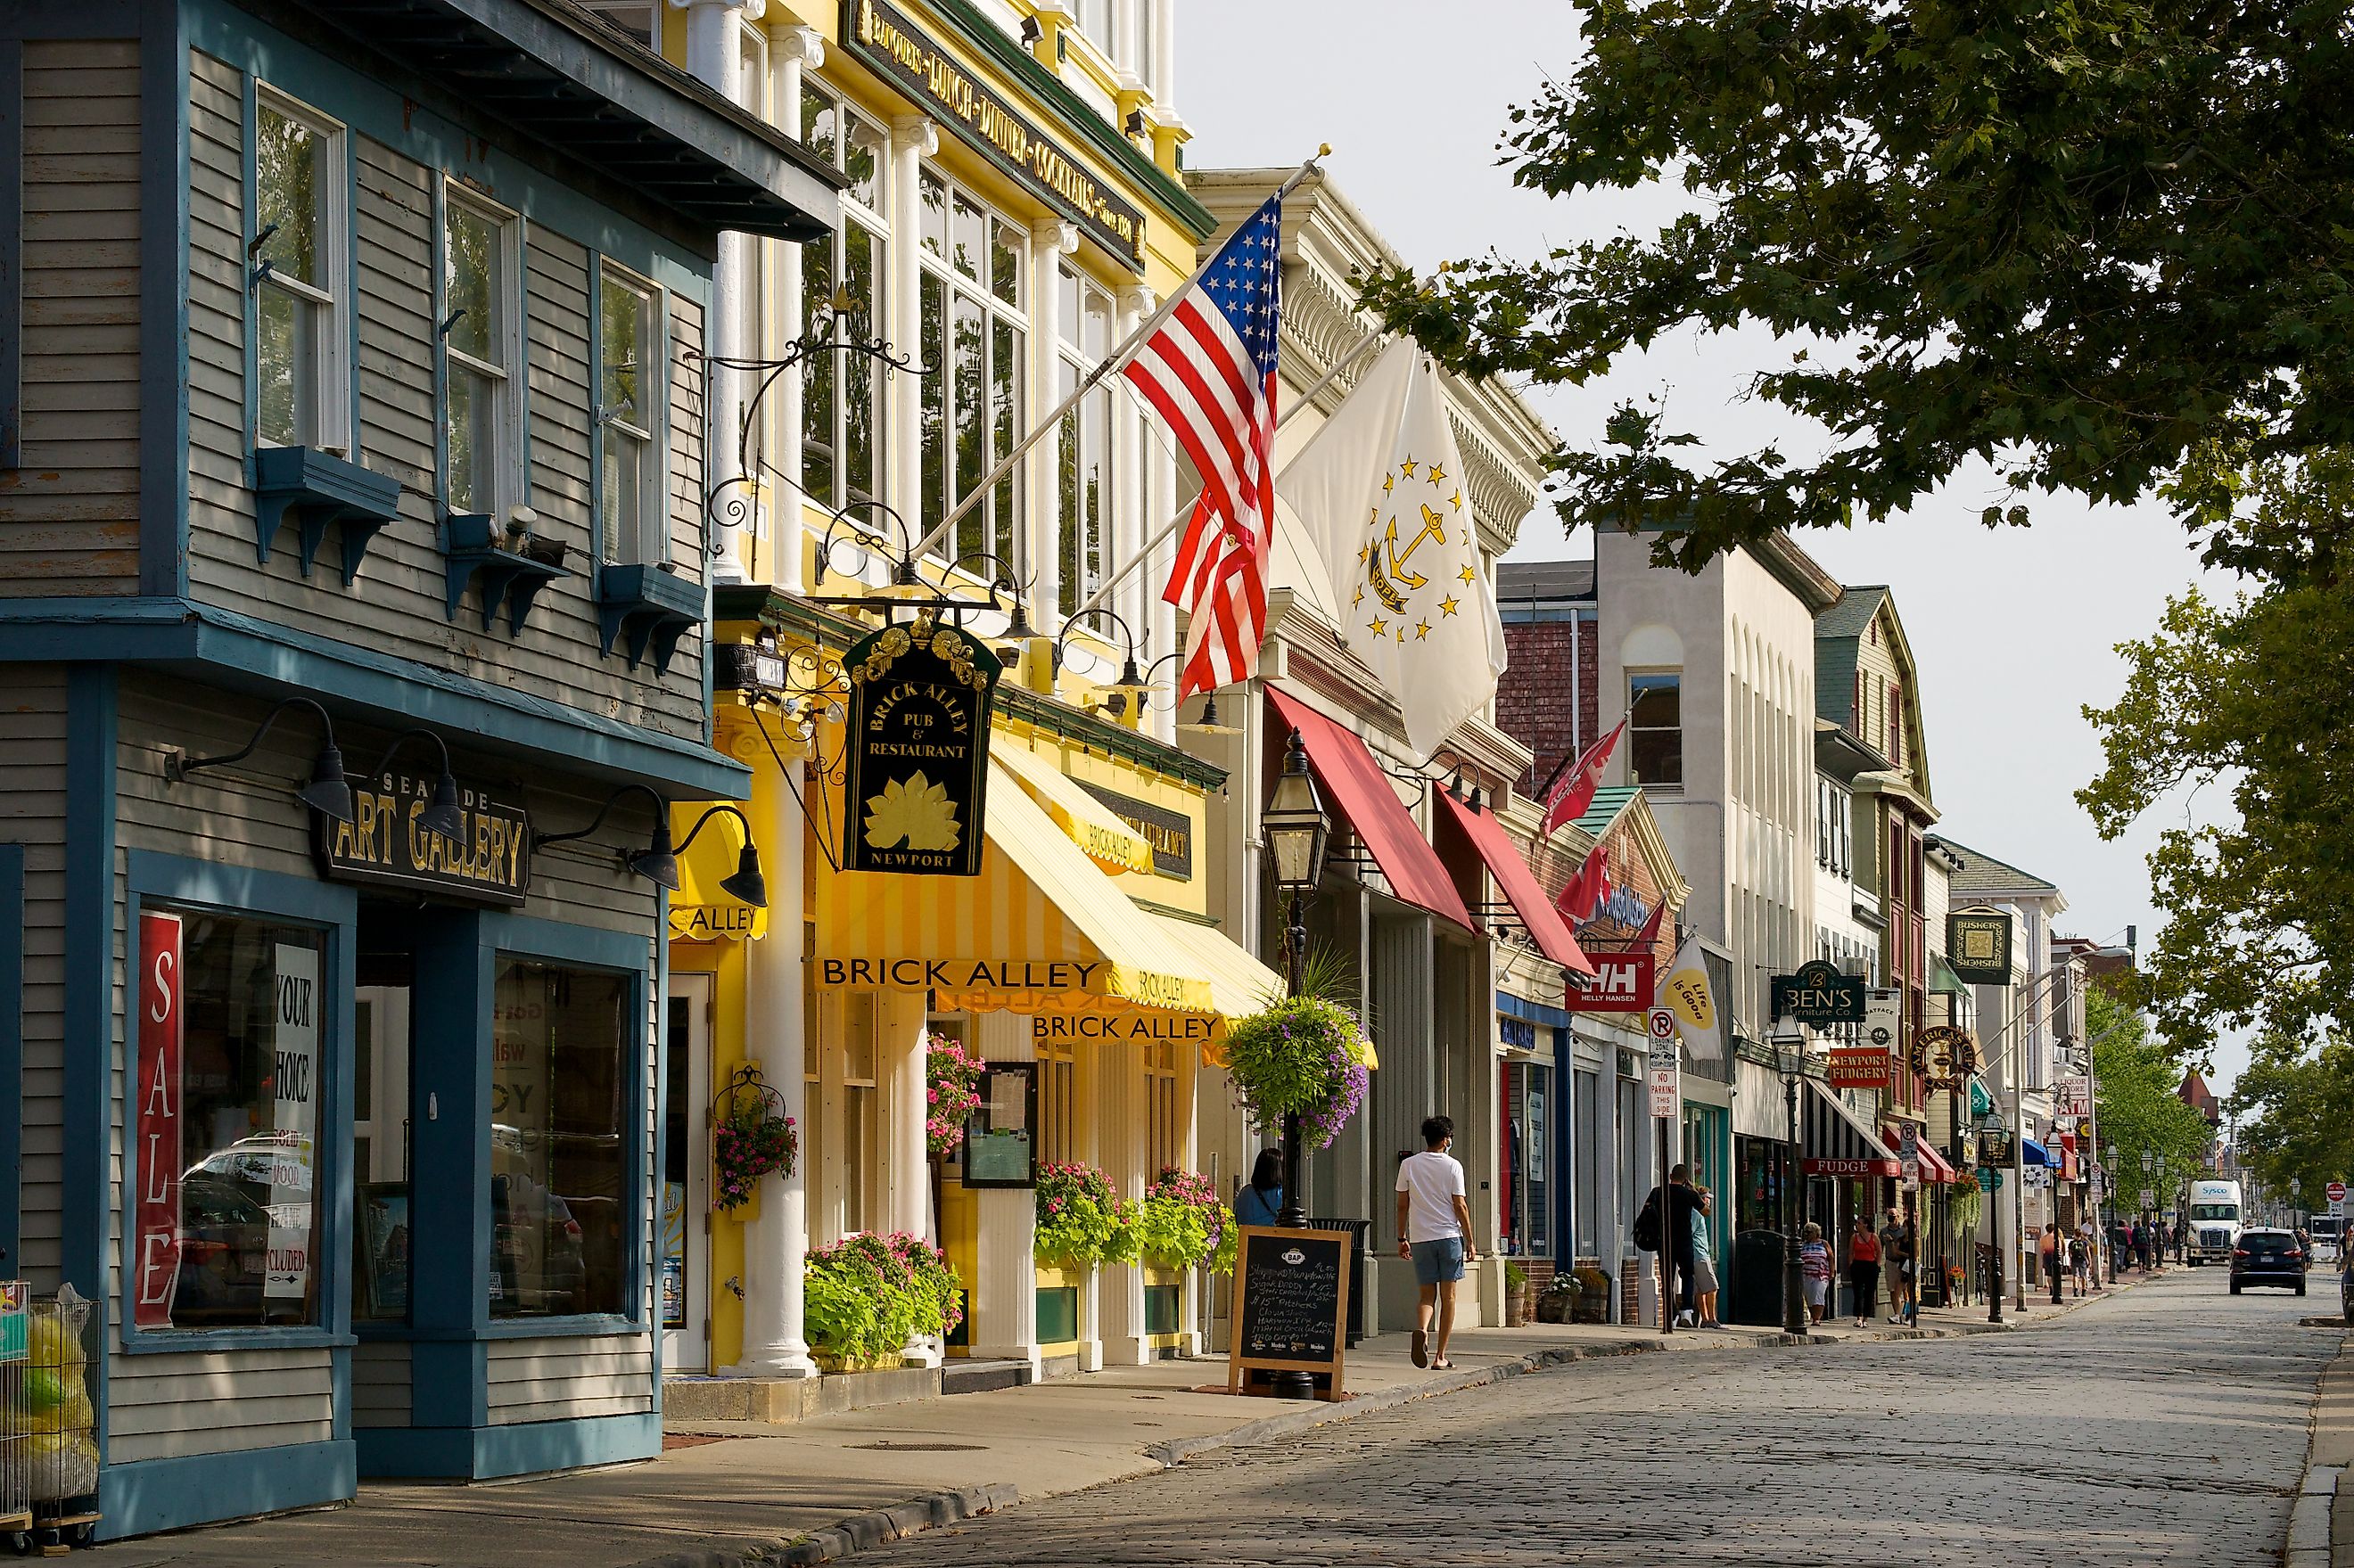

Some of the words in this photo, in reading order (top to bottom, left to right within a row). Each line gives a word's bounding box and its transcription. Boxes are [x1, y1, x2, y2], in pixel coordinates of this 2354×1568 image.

[872, 12, 922, 76] BANQUETS
[928, 52, 973, 122] LUNCH
[977, 94, 1027, 167] DINNER
[1033, 142, 1095, 219] COCKTAILS
[869, 682, 917, 731] BRICK
[924, 685, 967, 736] ALLEY
[903, 714, 934, 727] PUB
[912, 730, 923, 740] &
[869, 743, 966, 759] RESTAURANT
[383, 772, 488, 810] SEADE
[333, 790, 398, 865] ART
[408, 800, 524, 887] GALLERY
[1089, 825, 1111, 851] BRICK
[1112, 831, 1132, 860] ALLEY
[871, 853, 953, 867] NEWPORT
[690, 908, 756, 931] ALLEY
[1957, 921, 2003, 930] BUSKERS
[824, 958, 952, 987] BRICK
[966, 961, 1099, 988] ALLEY
[1673, 980, 1684, 990] is
[1682, 989, 1703, 1020] Good
[1691, 983, 1707, 1007] Life
[1786, 989, 1852, 1007] BEN'S
[1794, 1008, 1832, 1016] urniture
[1836, 1008, 1853, 1016] Co.
[1033, 1016, 1120, 1039] BRICK
[1130, 1017, 1217, 1039] ALLEY
[1831, 1055, 1887, 1066] NEWPORT
[1962, 1043, 1973, 1067] CUP
[276, 1051, 309, 1103] HOICE
[1658, 1072, 1668, 1082] NO
[1831, 1068, 1887, 1080] FUDGERY
[1650, 1086, 1675, 1095] PARKING
[2059, 1100, 2089, 1114] ATM
[139, 950, 174, 1305] SALE
[1817, 1161, 1869, 1172] FUDGE
[2202, 1186, 2227, 1194] Sysco
[268, 1250, 304, 1272] CLUDED
